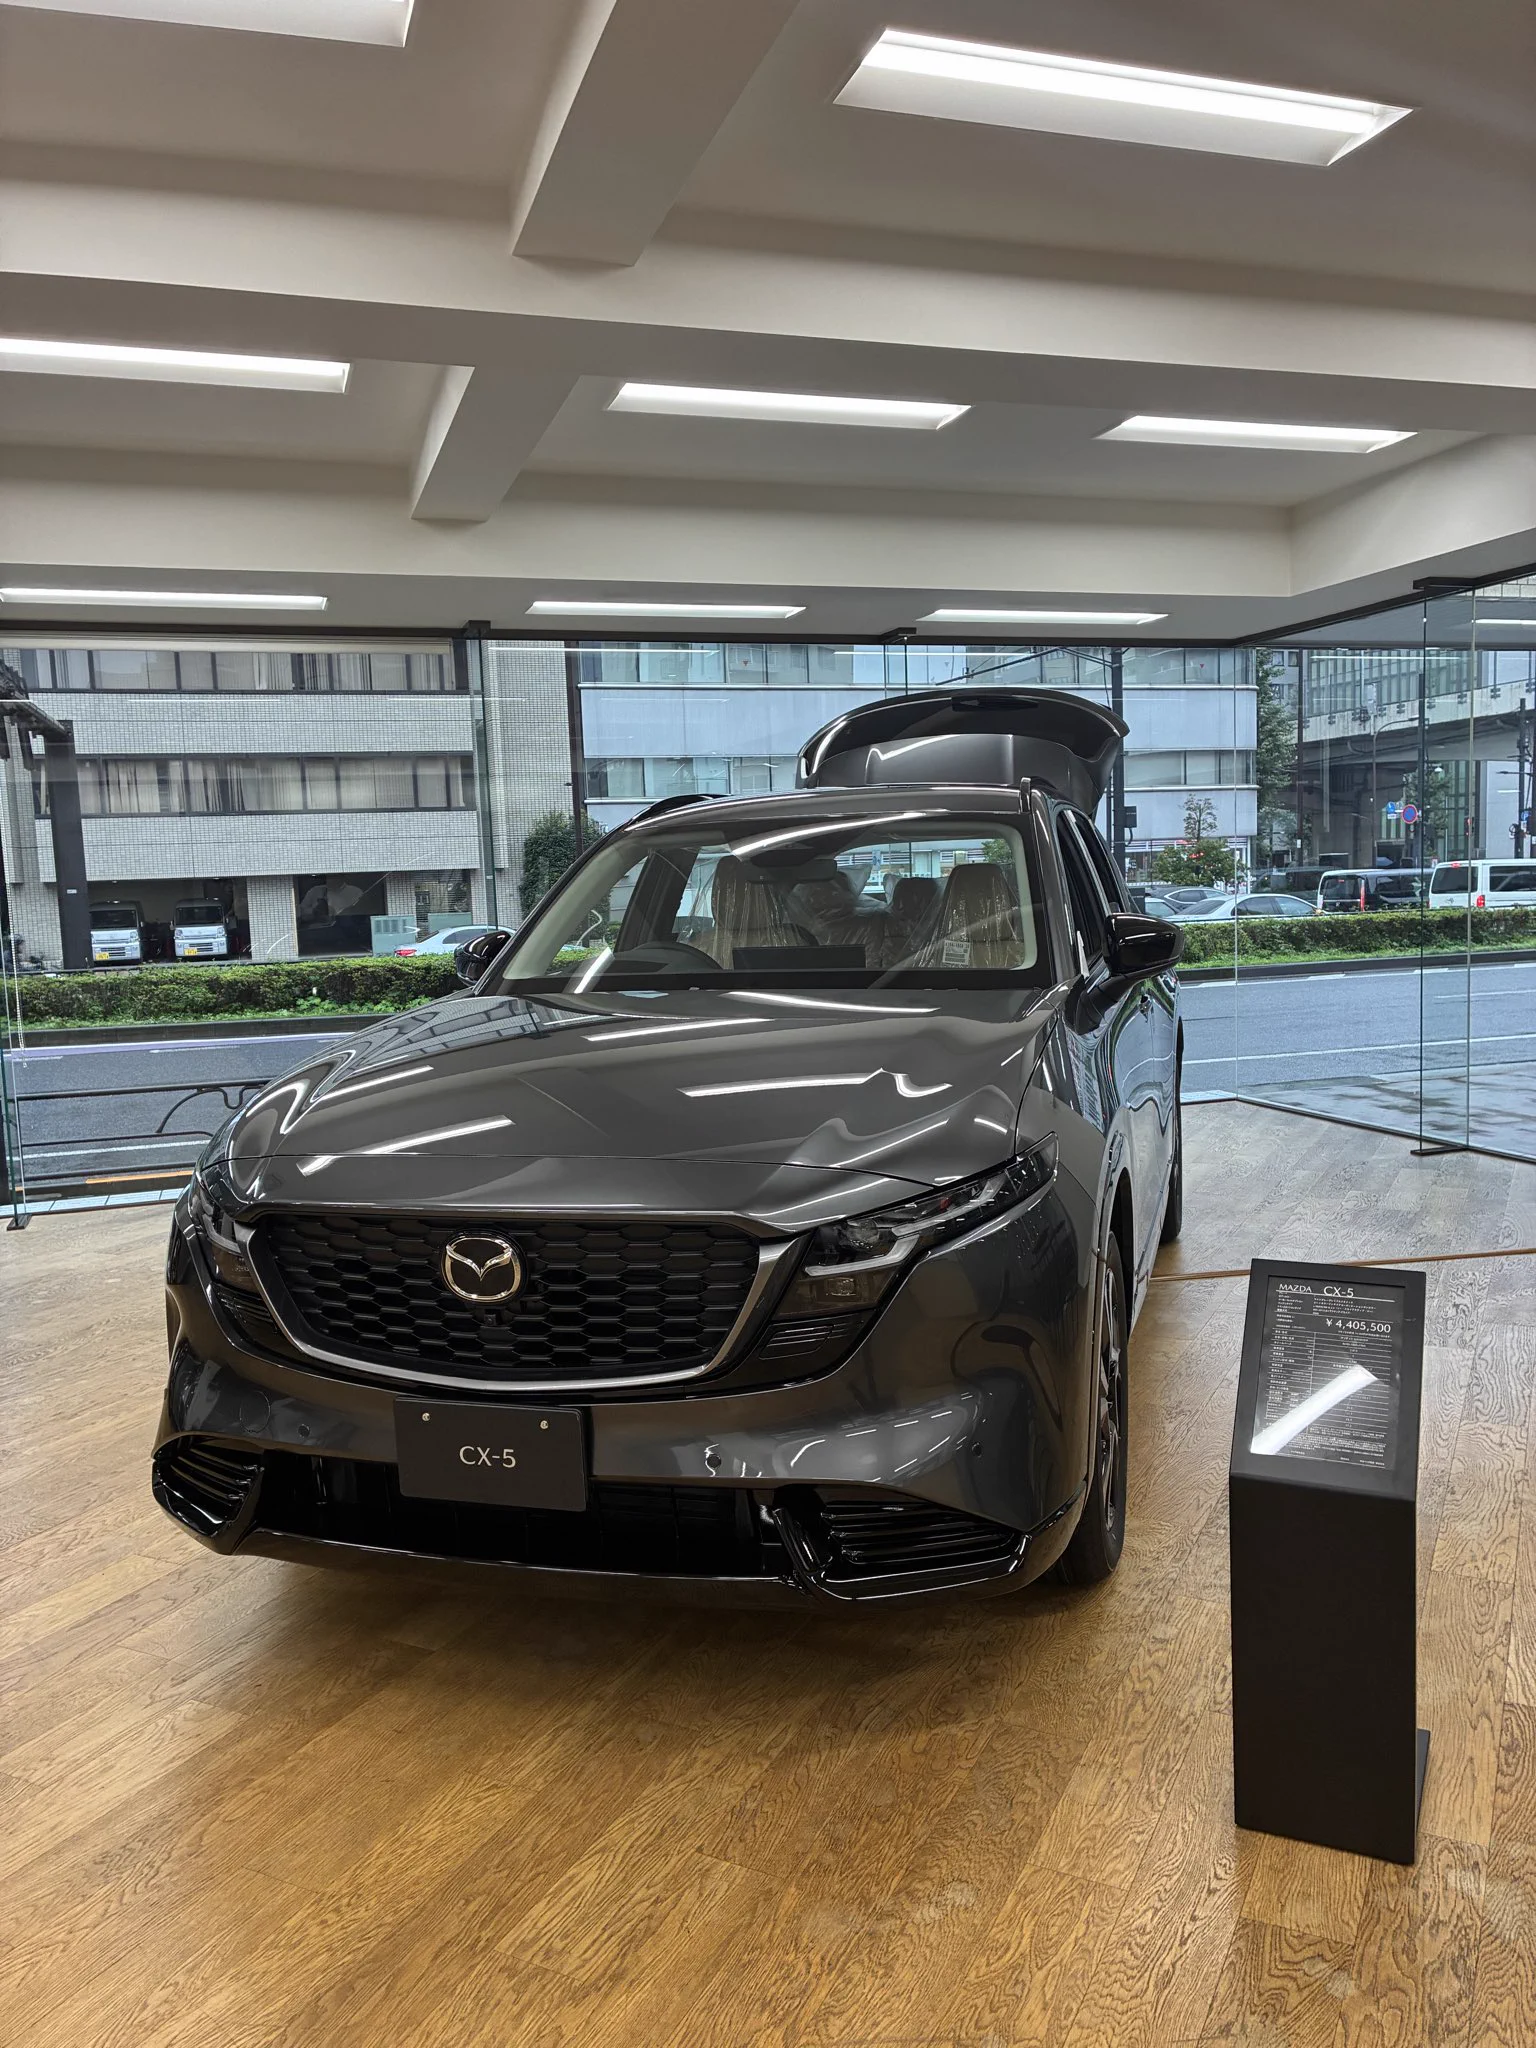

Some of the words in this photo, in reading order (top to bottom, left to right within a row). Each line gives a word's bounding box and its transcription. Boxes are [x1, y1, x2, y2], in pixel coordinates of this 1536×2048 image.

[1278, 1283, 1312, 1293] MAZDA
[1323, 1286, 1354, 1298] CX-5
[1335, 1319, 1391, 1333] 4,405,500
[458, 1445, 517, 1469] CX-5
